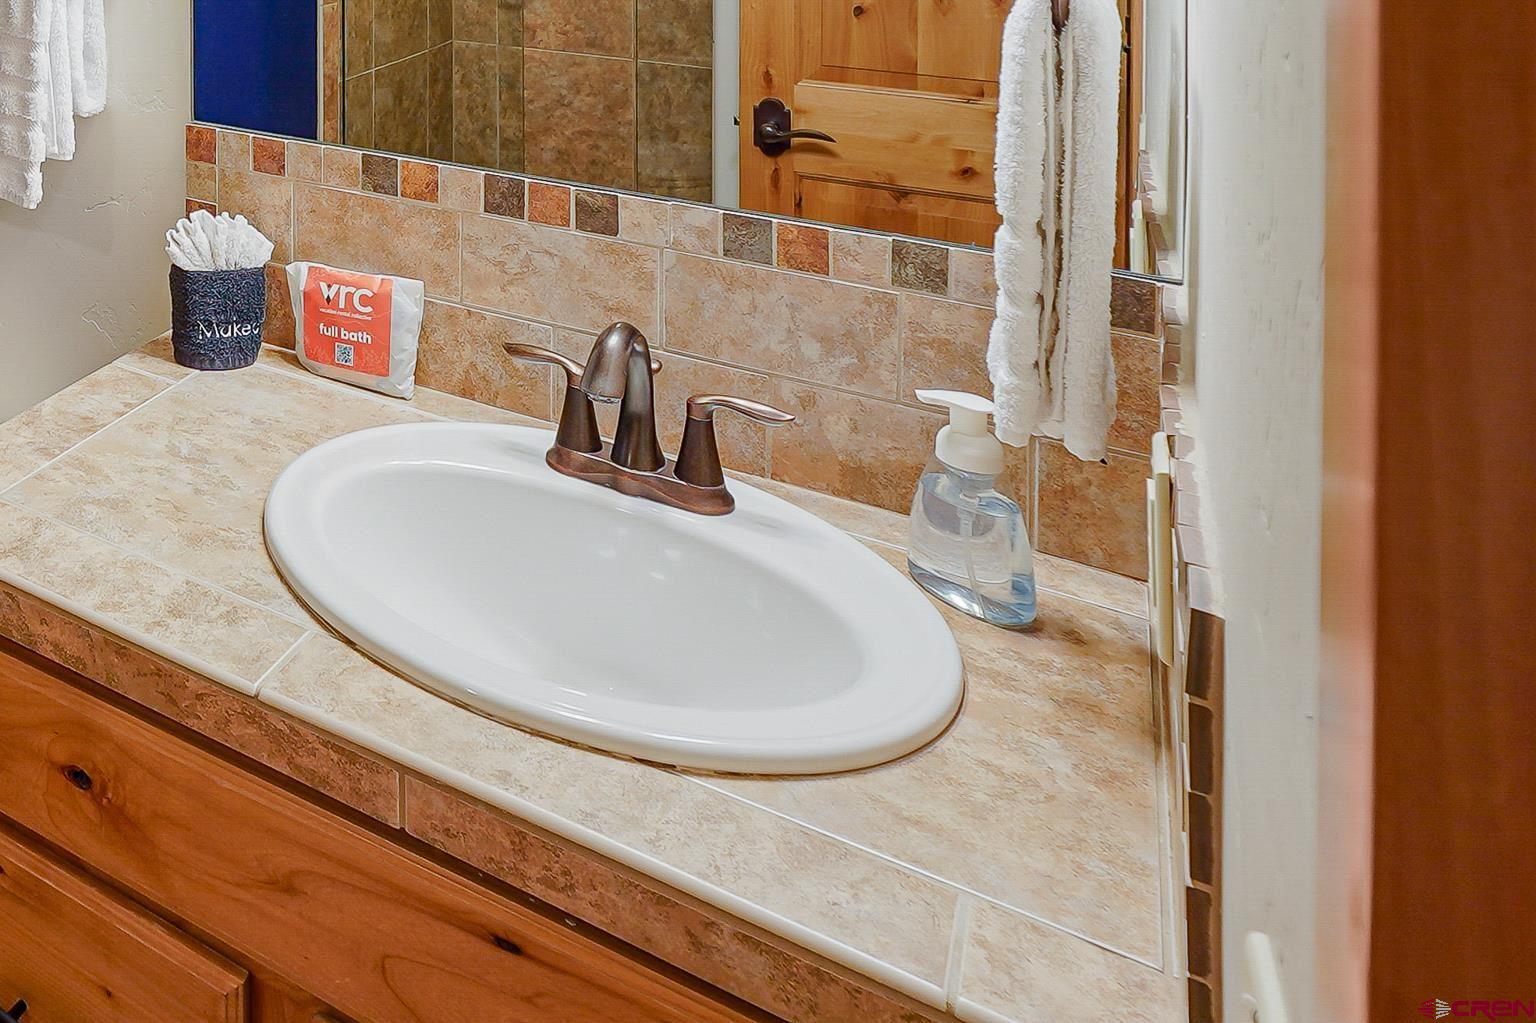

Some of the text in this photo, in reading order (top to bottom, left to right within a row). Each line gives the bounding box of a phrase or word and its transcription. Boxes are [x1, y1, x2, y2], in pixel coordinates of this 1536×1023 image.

[319, 281, 374, 313] vrc
[319, 322, 372, 345] full bath
